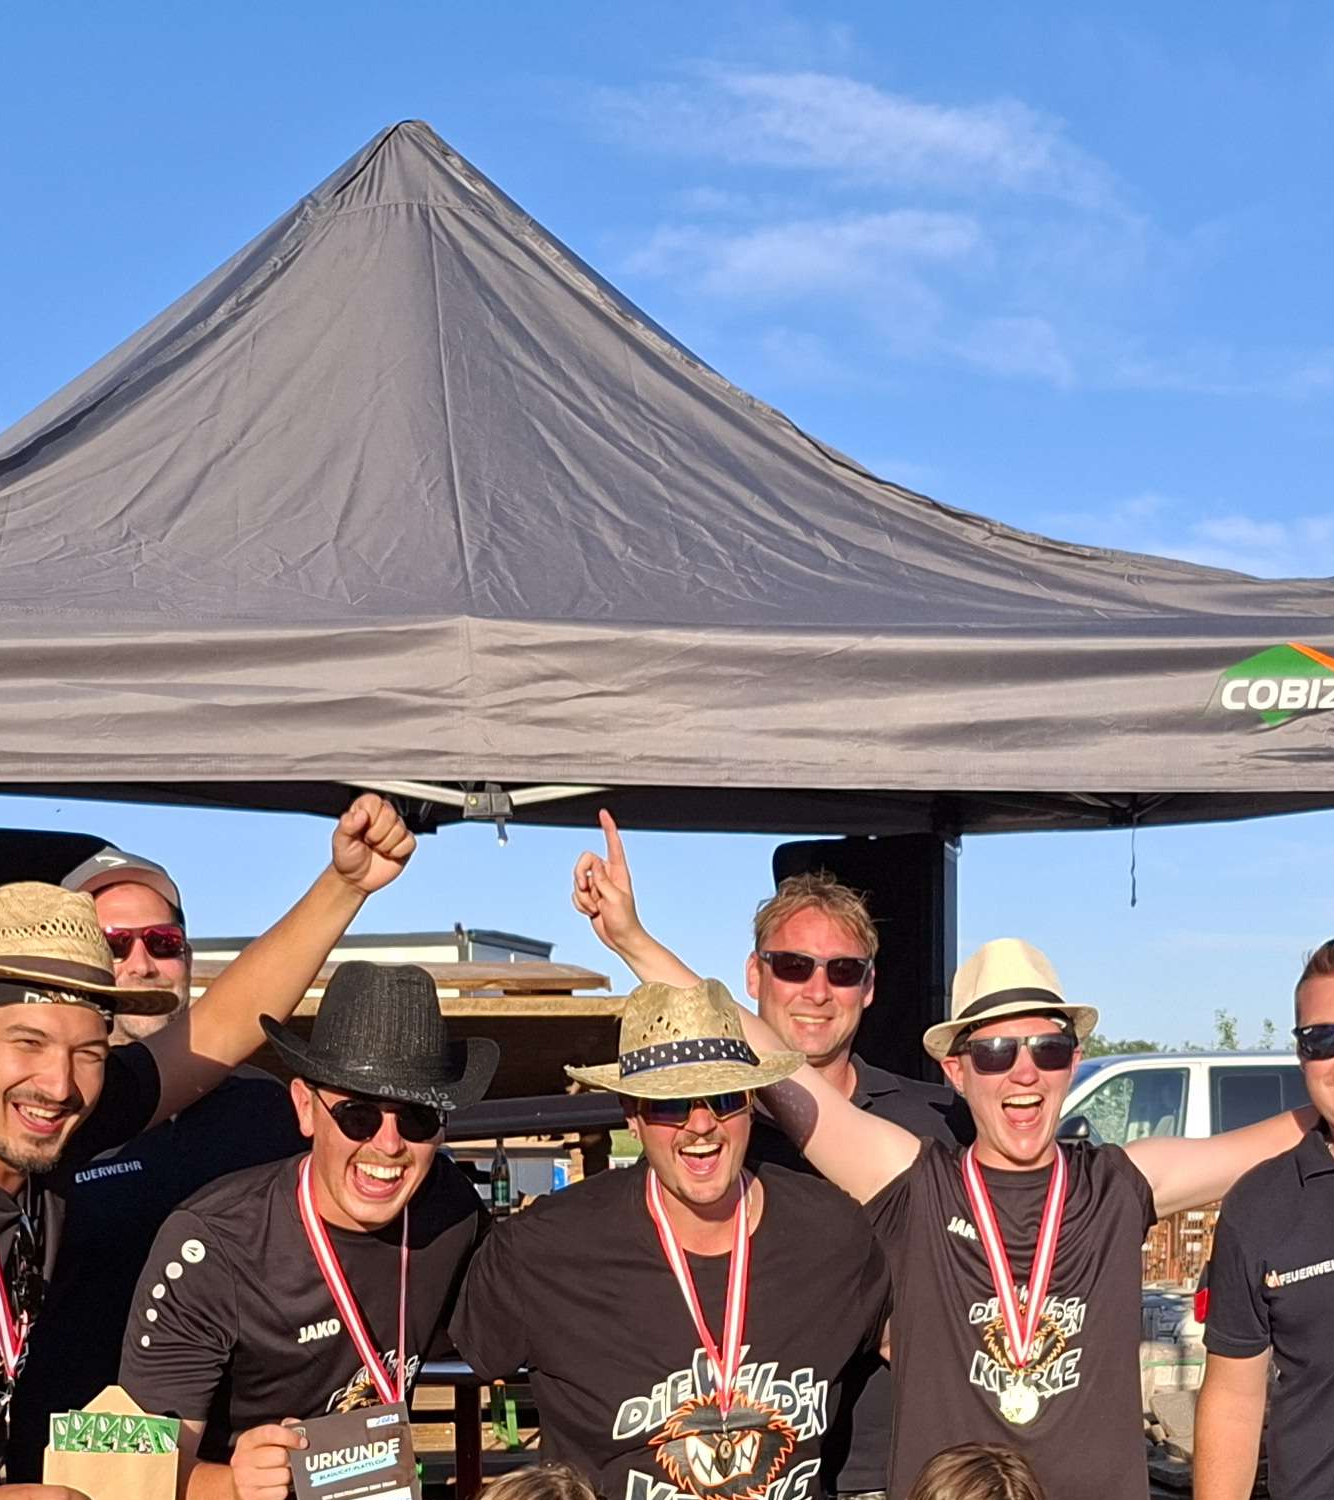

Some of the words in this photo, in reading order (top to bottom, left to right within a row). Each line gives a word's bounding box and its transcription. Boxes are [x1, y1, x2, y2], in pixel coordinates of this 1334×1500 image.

[75, 1160, 143, 1184] EUERWEHR
[297, 1318, 341, 1344] JAKO
[305, 1437, 401, 1472] URKUNDE
